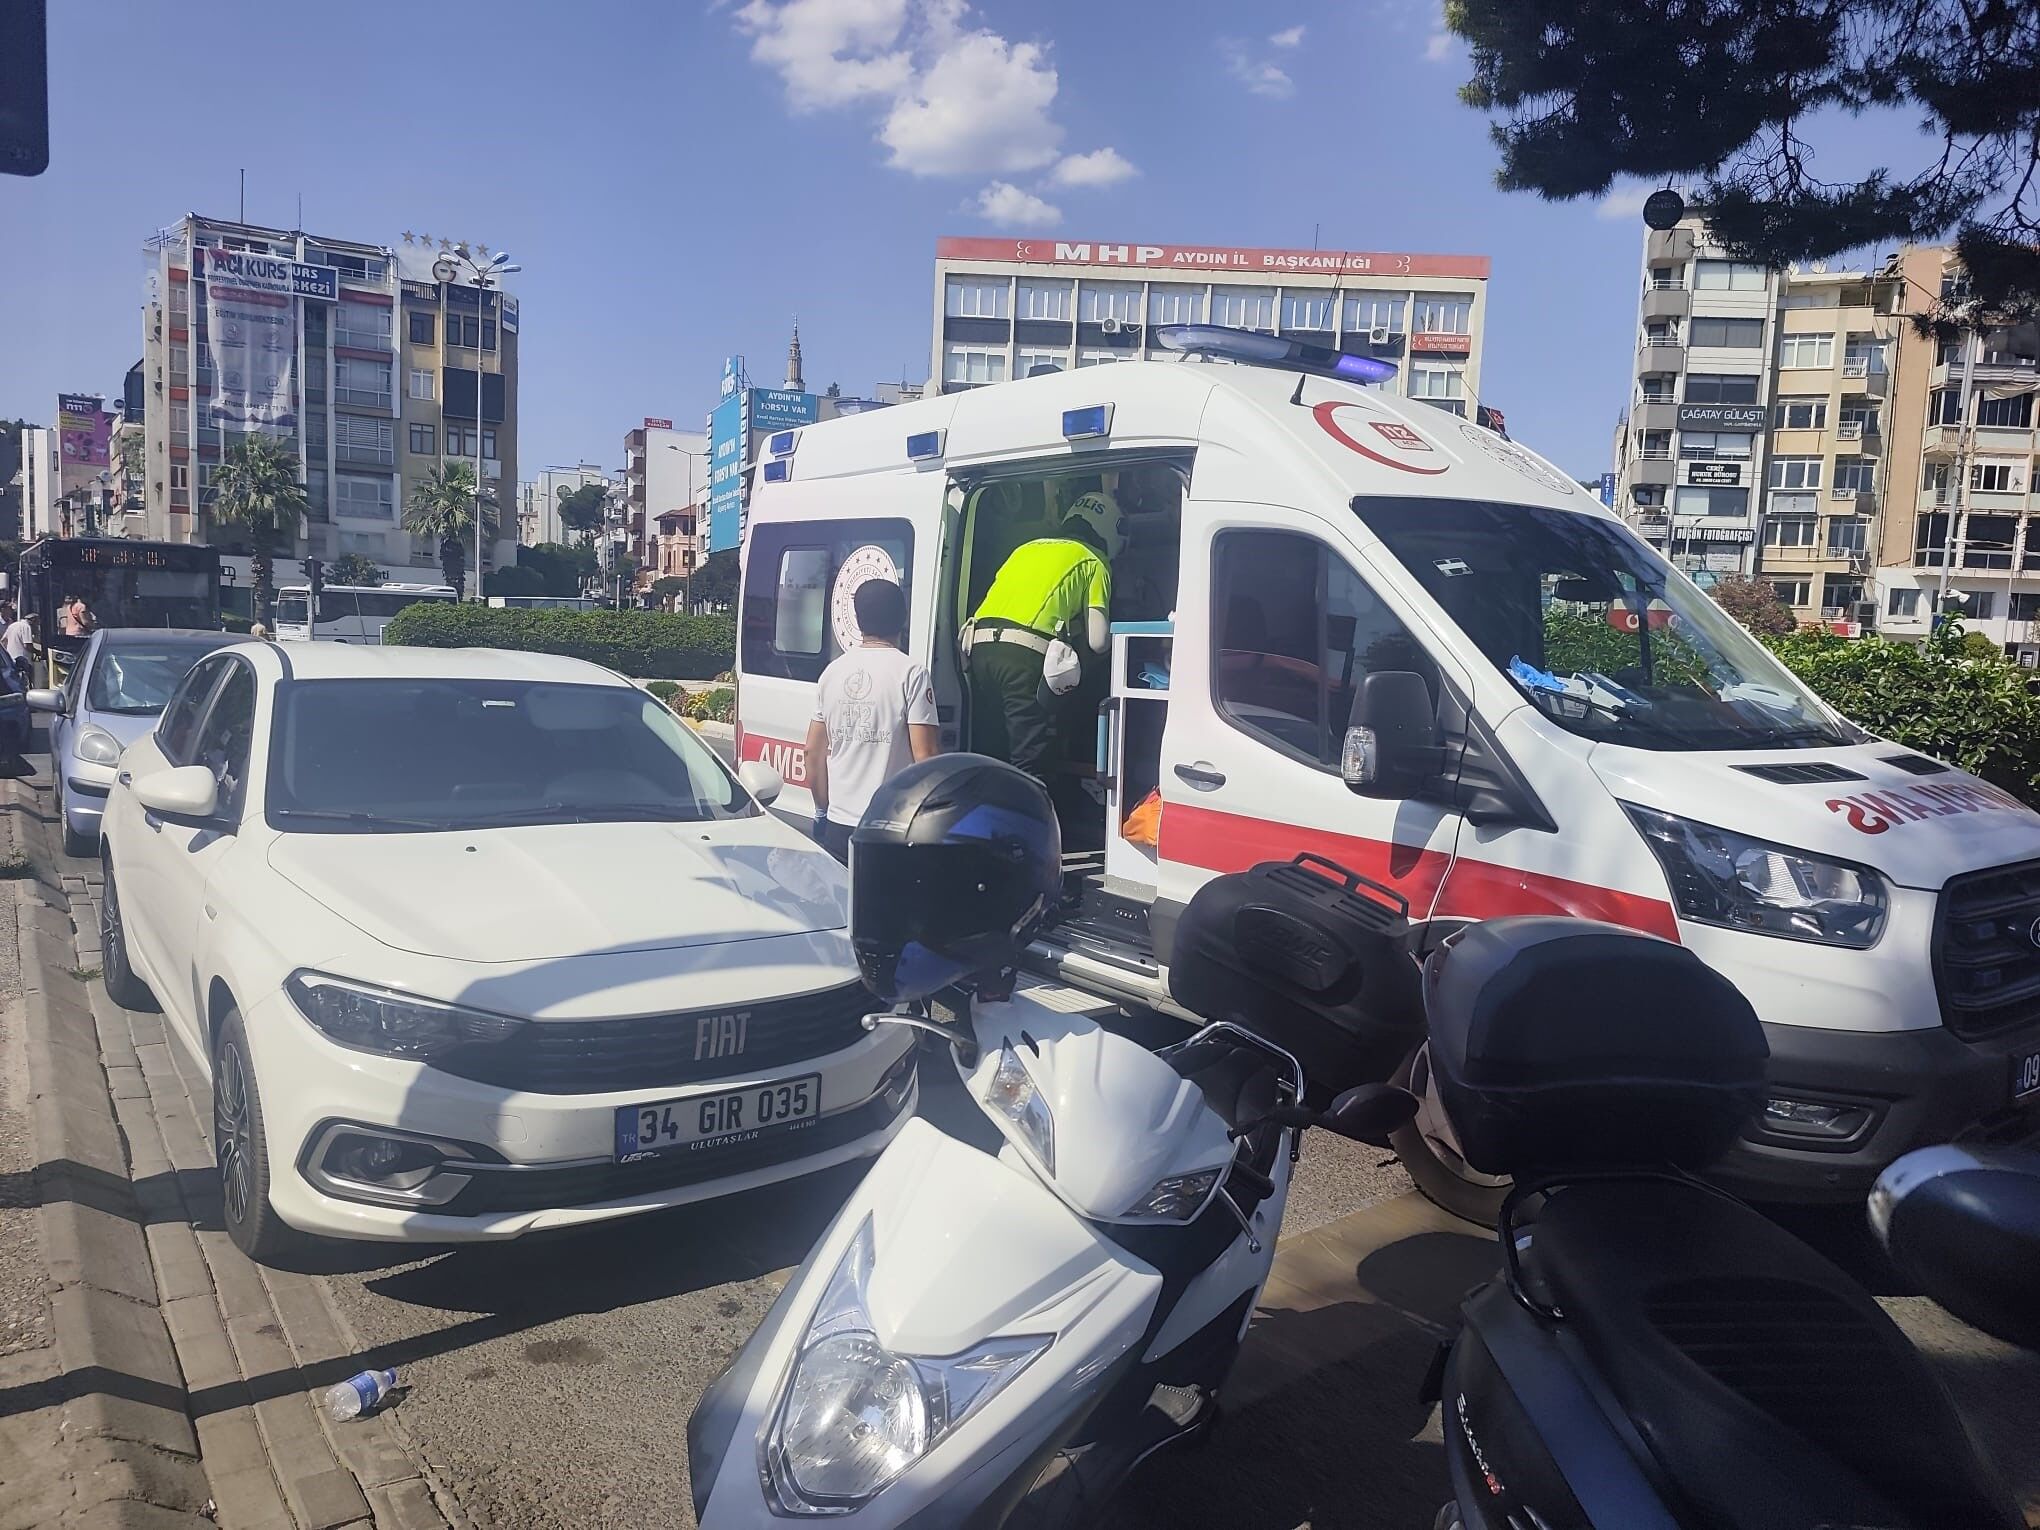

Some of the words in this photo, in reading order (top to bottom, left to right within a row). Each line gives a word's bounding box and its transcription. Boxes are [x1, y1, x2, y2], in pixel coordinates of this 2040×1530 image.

[1055, 243, 1165, 263] MHP
[1173, 252, 1227, 265] AYDIN
[1233, 250, 1249, 265] İL
[1263, 254, 1371, 270] BAŞKANLIĞI
[246, 257, 287, 280] KURS
[292, 265, 319, 279] URS
[791, 405, 807, 414] VAR
[1681, 407, 1722, 420] ÇAĞATAY
[1724, 408, 1764, 422] GÜLAŞTI
[1378, 425, 1416, 439] 112
[1074, 498, 1106, 515] OLİS
[758, 742, 807, 782] AMB
[694, 1012, 751, 1062] FIAT
[622, 1133, 637, 1144] TR
[640, 1107, 678, 1144] 34
[699, 1095, 743, 1134] GIR
[757, 1083, 808, 1123] 035
